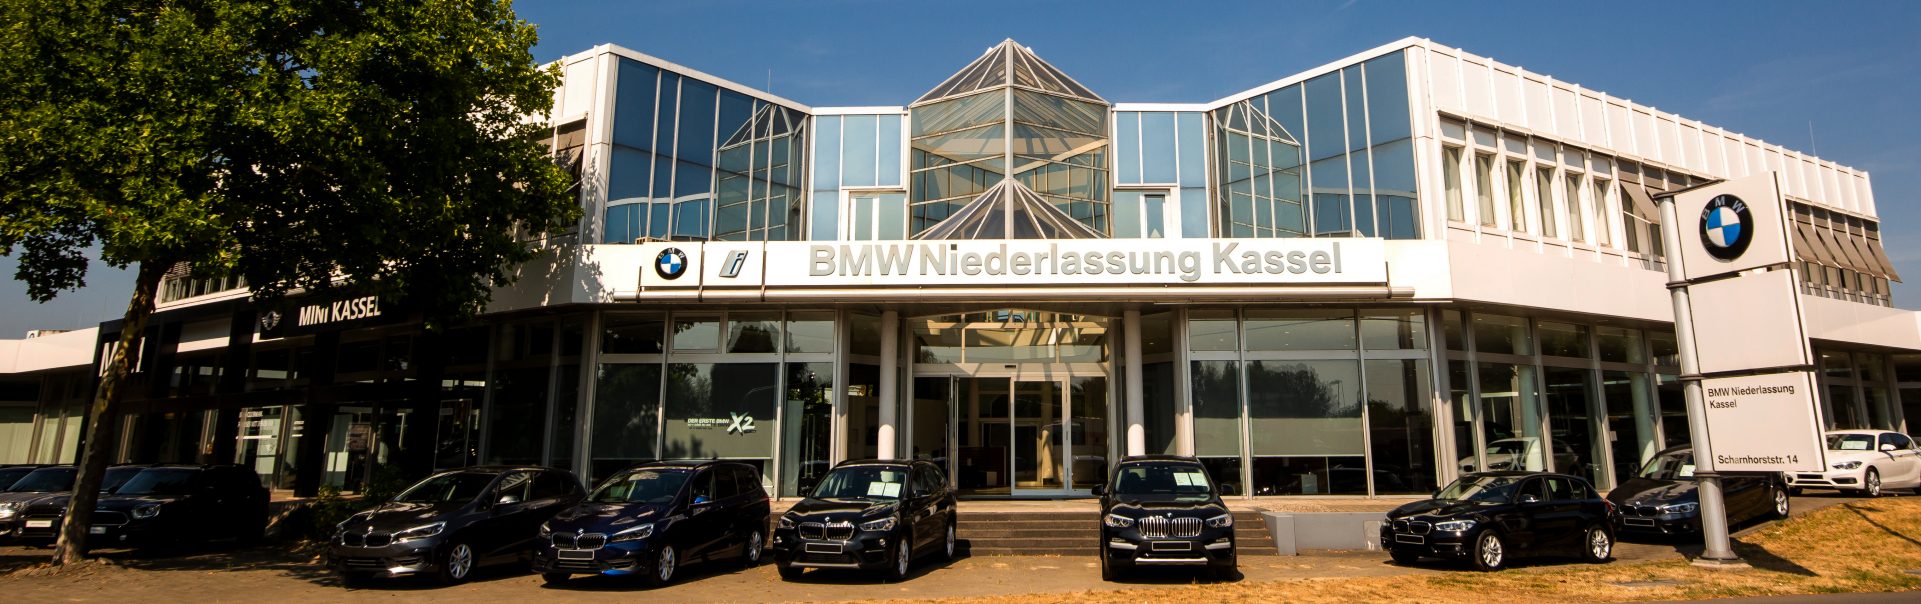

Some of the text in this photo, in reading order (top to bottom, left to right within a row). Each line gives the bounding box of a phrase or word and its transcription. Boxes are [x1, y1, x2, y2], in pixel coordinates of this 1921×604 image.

[1701, 195, 1745, 221] BMW
[809, 242, 1343, 283] BMW Niederlassung Kassel
[331, 296, 381, 322] KASSEL
[1708, 385, 1795, 398] BMW Niederlassung
[1709, 399, 1737, 409] Kassel
[726, 411, 756, 433] X2
[1717, 454, 1799, 465] Scharnhorststr. 14
